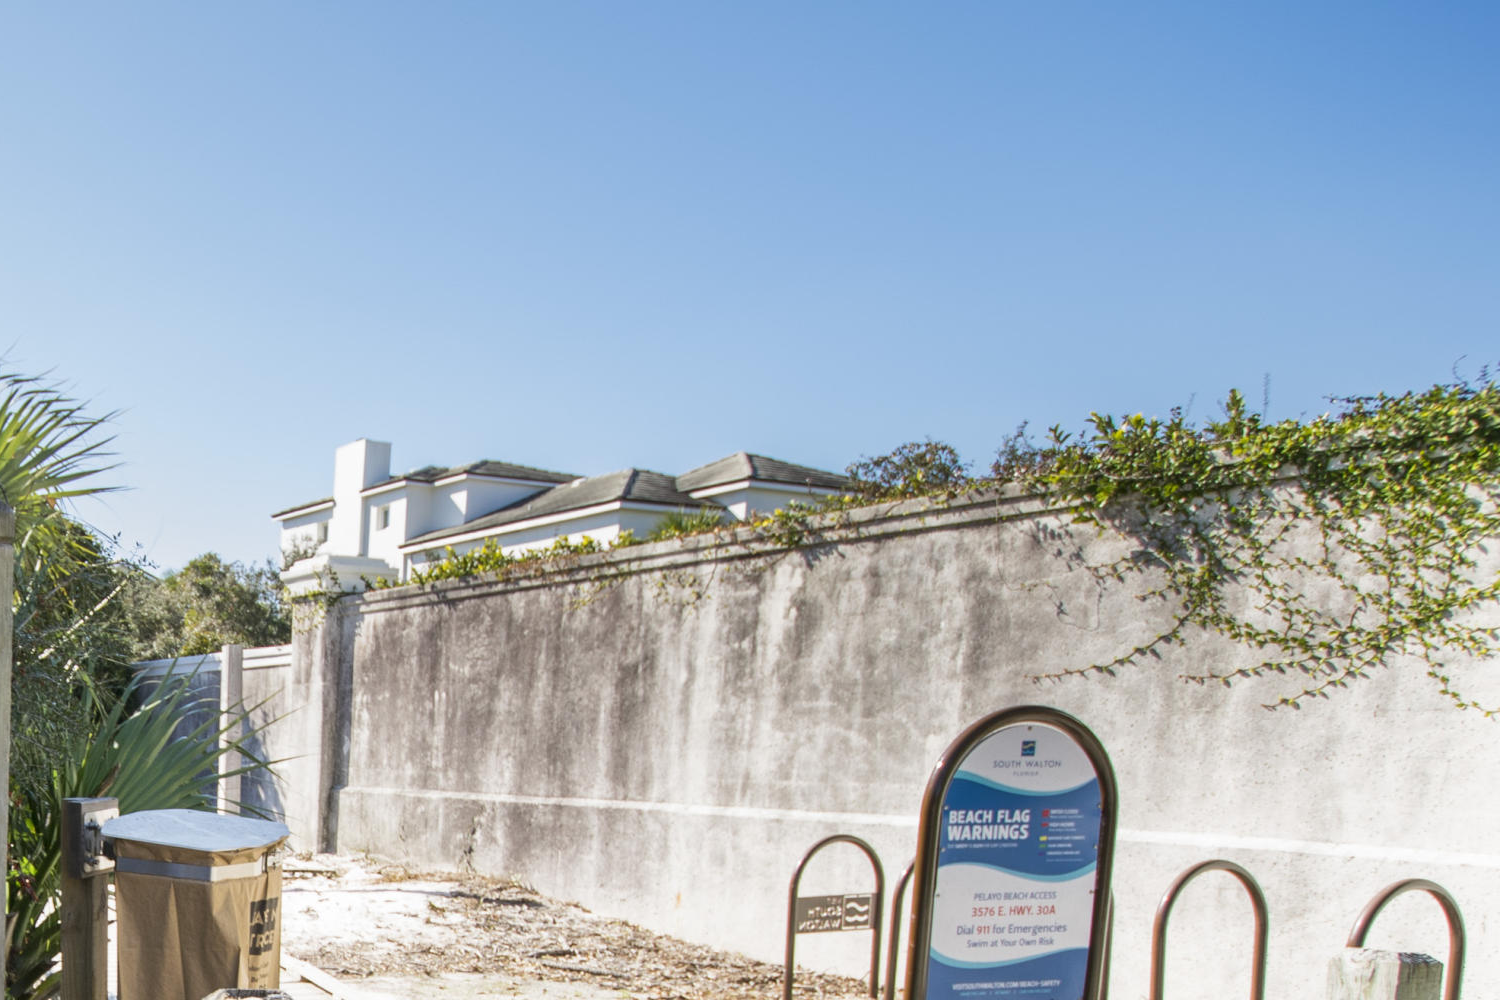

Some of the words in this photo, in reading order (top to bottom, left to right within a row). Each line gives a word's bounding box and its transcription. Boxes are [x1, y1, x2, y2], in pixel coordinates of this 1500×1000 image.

[993, 759, 1021, 769] SOUTH
[1025, 759, 1062, 769] WALTON
[948, 810, 993, 824] BEACH
[996, 808, 1031, 823] FLAG
[947, 824, 1030, 841] WARNINGS
[973, 892, 1002, 901] PELAYO
[1003, 891, 1028, 901] BEACH
[1029, 890, 1057, 900] ACCESS
[971, 906, 996, 918] 3576
[997, 905, 1006, 917] E.
[1008, 904, 1034, 916] HWY.
[1036, 904, 1056, 915] 30A
[956, 925, 974, 935] Dial
[976, 924, 991, 935] 911
[992, 923, 1006, 934] for
[1007, 922, 1068, 936] Emergencies
[967, 939, 988, 949] Swim
[990, 940, 999, 948] at
[1001, 939, 1017, 947] Your
[1019, 938, 1037, 946] Own
[1038, 937, 1055, 945] Risk
